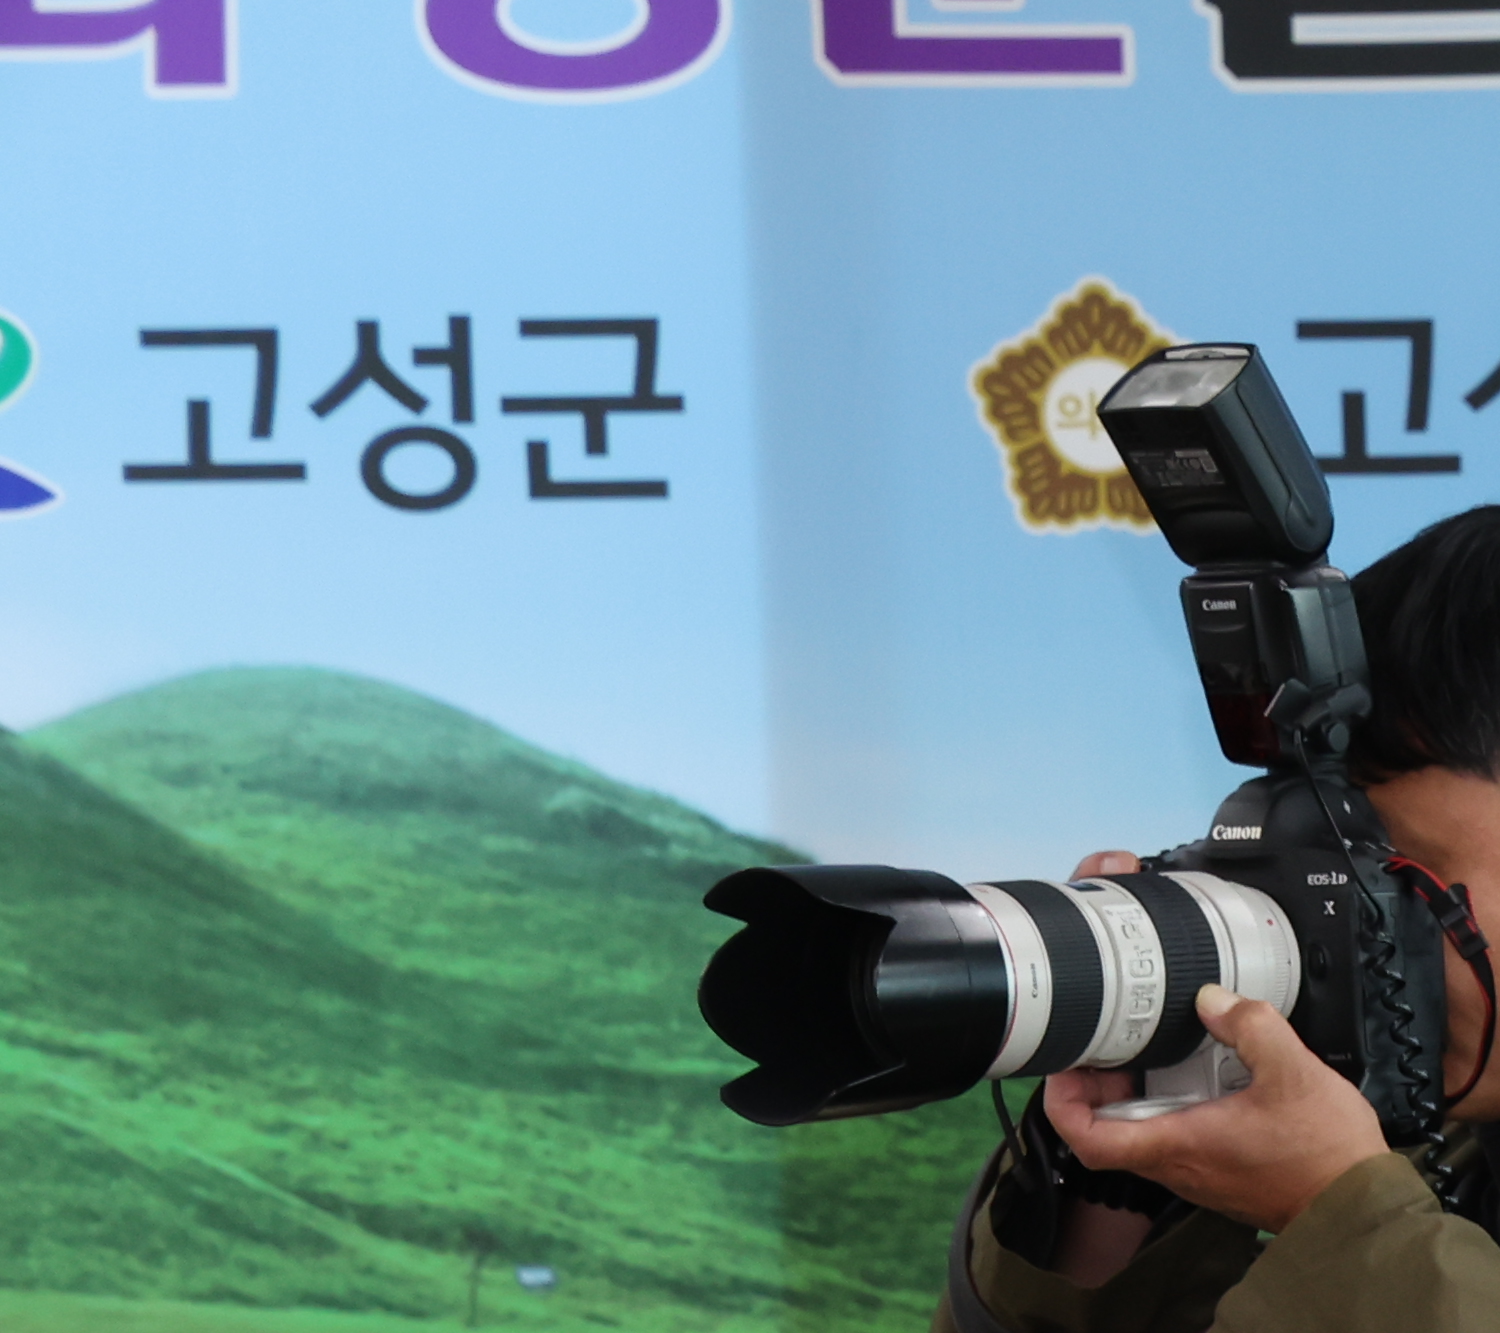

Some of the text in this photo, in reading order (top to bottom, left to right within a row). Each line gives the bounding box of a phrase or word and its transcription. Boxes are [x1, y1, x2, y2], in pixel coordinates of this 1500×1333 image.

[121, 312, 684, 513] 고성군
[1202, 599, 1237, 611] Canon
[1212, 823, 1262, 841] Canon
[1323, 900, 1335, 915] X
[1030, 963, 1038, 998] Canon
